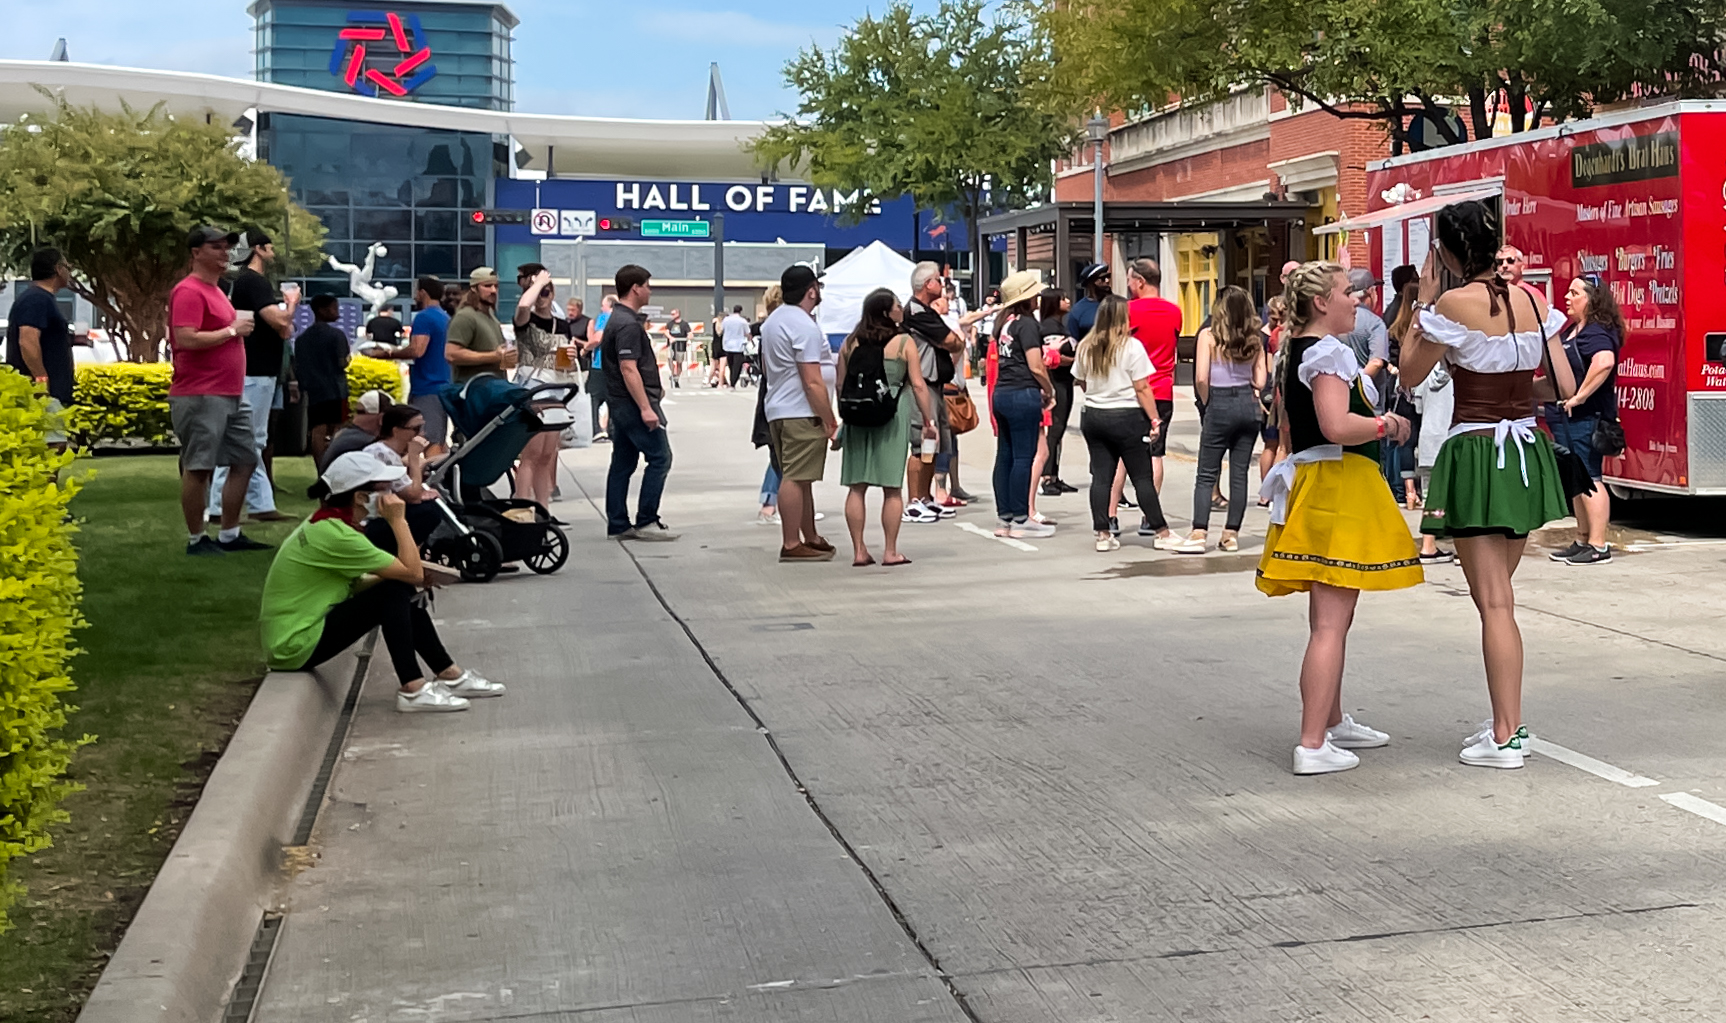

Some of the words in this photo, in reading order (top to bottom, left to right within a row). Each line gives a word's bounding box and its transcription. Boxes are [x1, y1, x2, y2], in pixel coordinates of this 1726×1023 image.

[616, 183, 710, 211] HALL
[725, 185, 775, 212] OF
[662, 222, 689, 232] Main
[1617, 357, 1664, 378] atHaus.com
[1614, 386, 1655, 410] 14-2808
